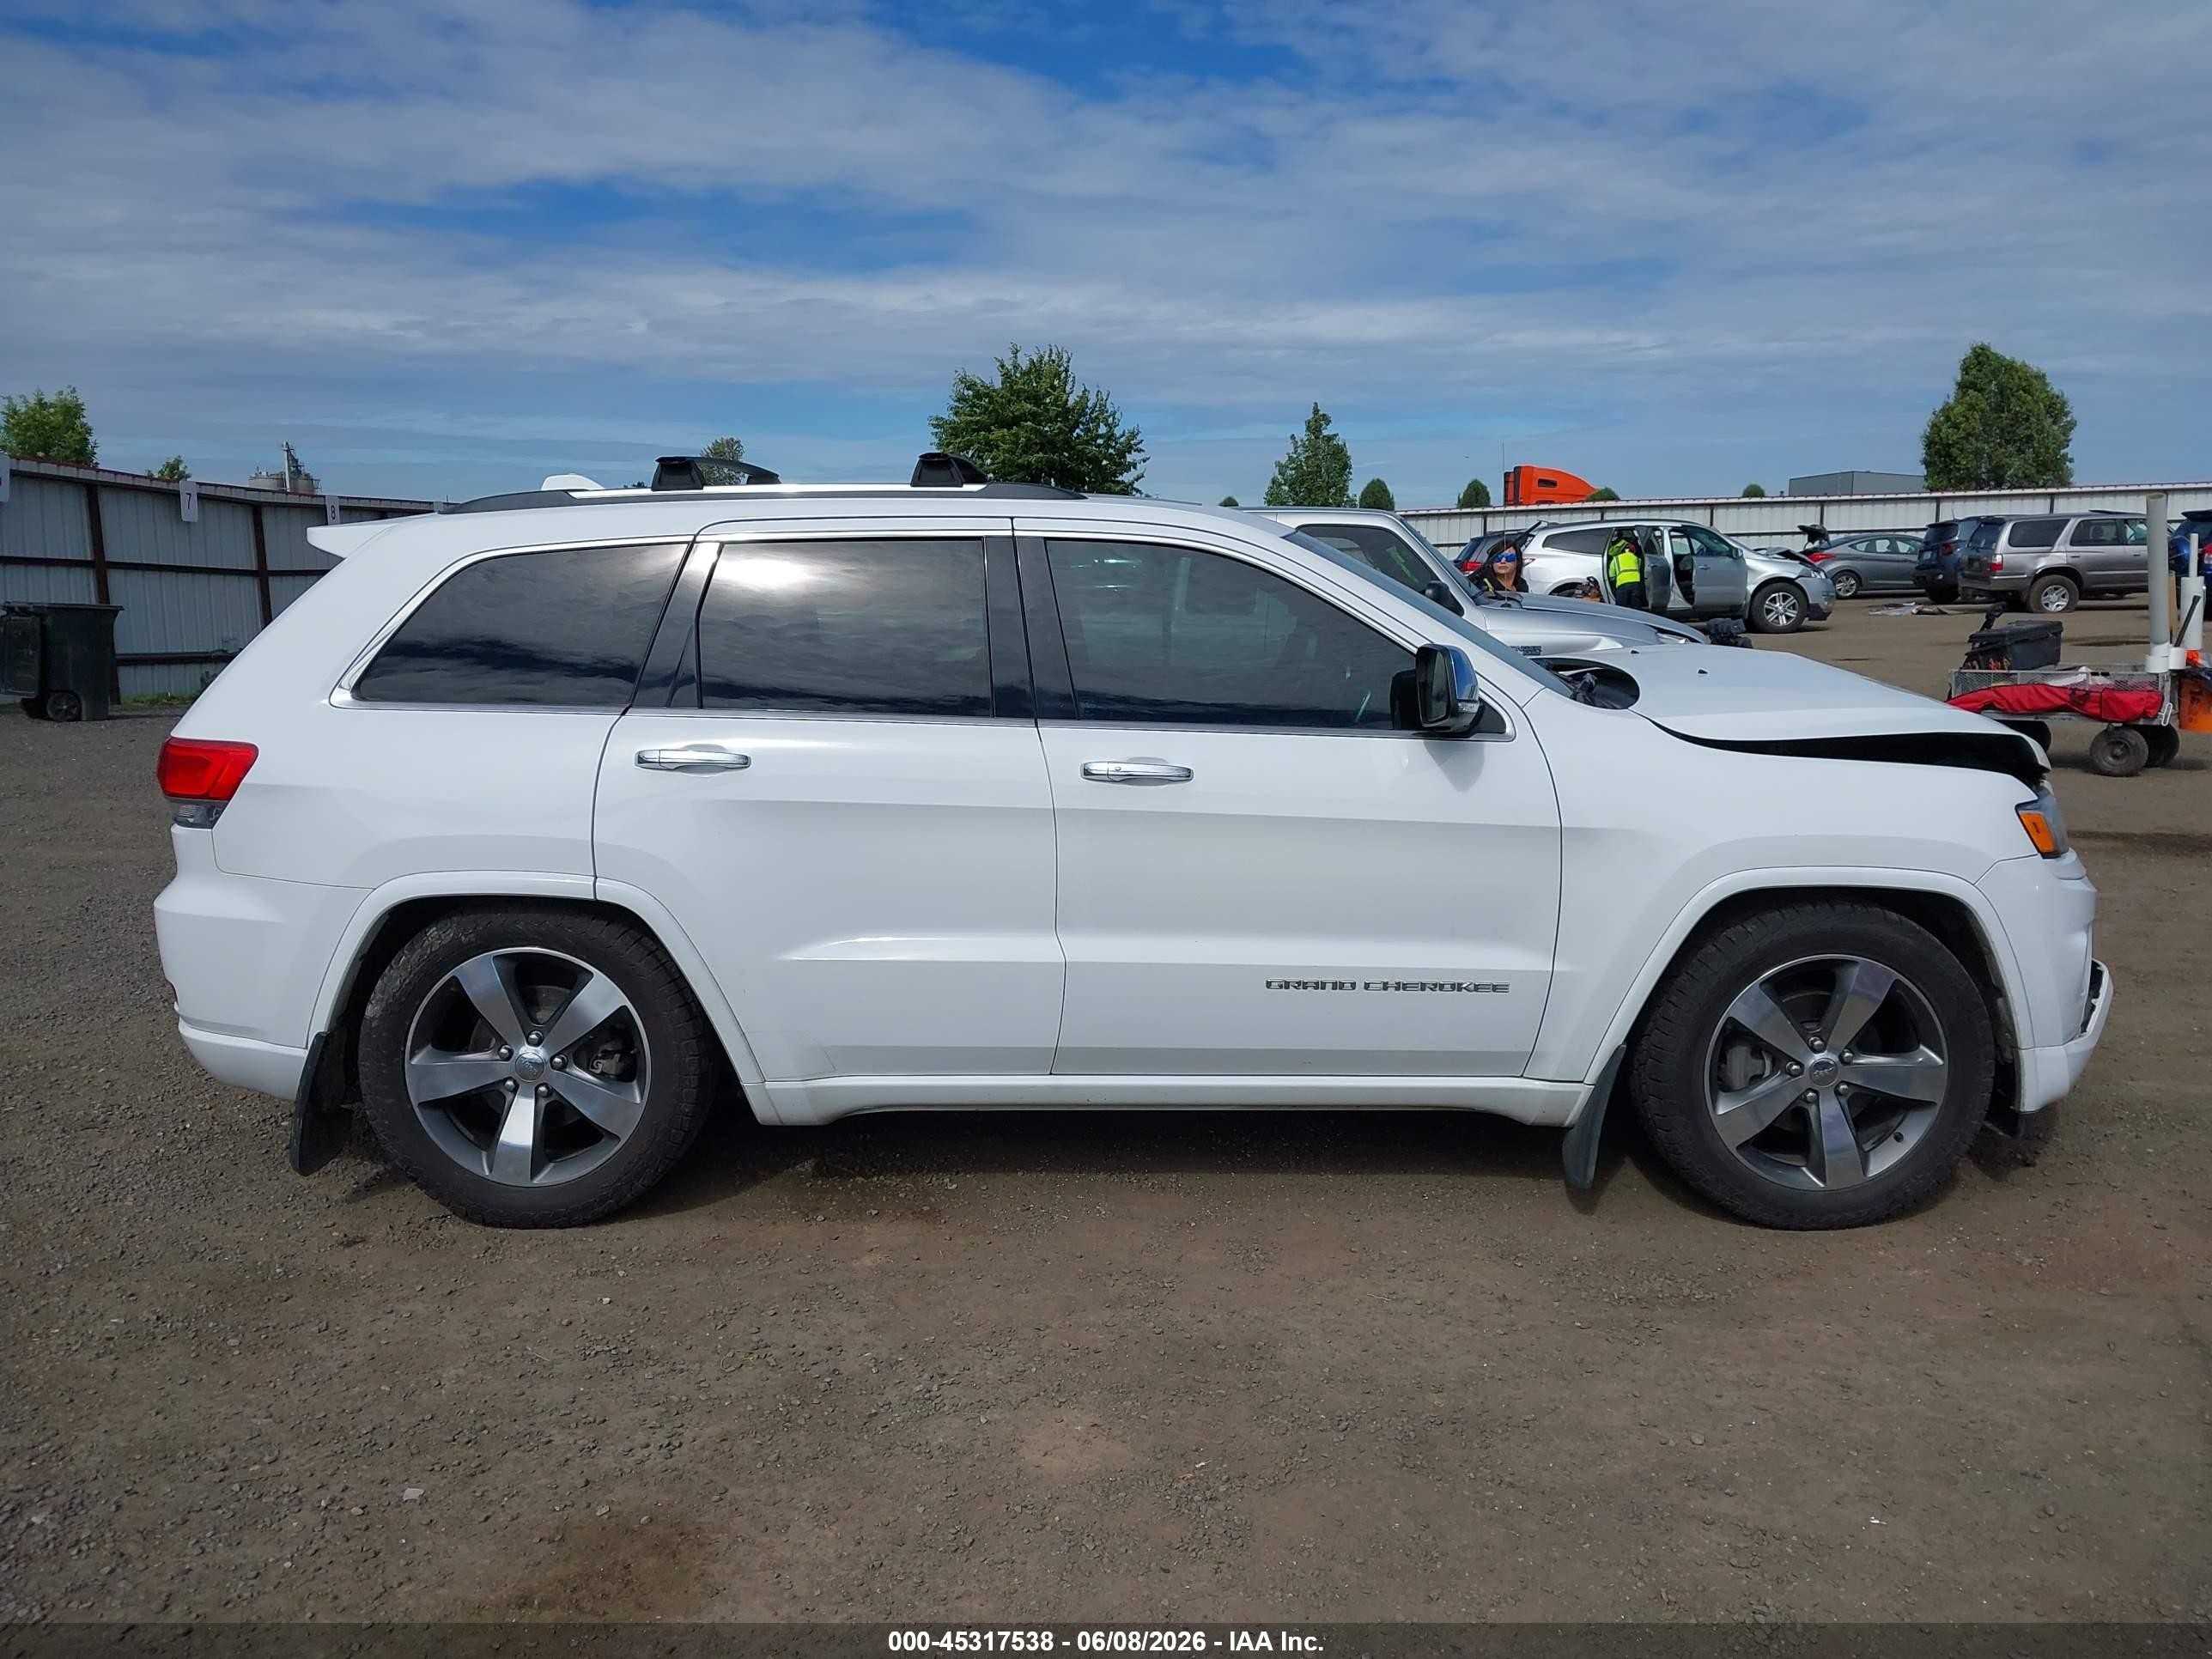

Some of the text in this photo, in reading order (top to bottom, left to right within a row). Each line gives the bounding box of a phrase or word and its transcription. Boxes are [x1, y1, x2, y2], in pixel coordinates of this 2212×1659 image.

[185, 492, 191, 509] 7
[331, 505, 336, 520] 8
[1266, 979, 1510, 993] GRAND CHEROKEE
